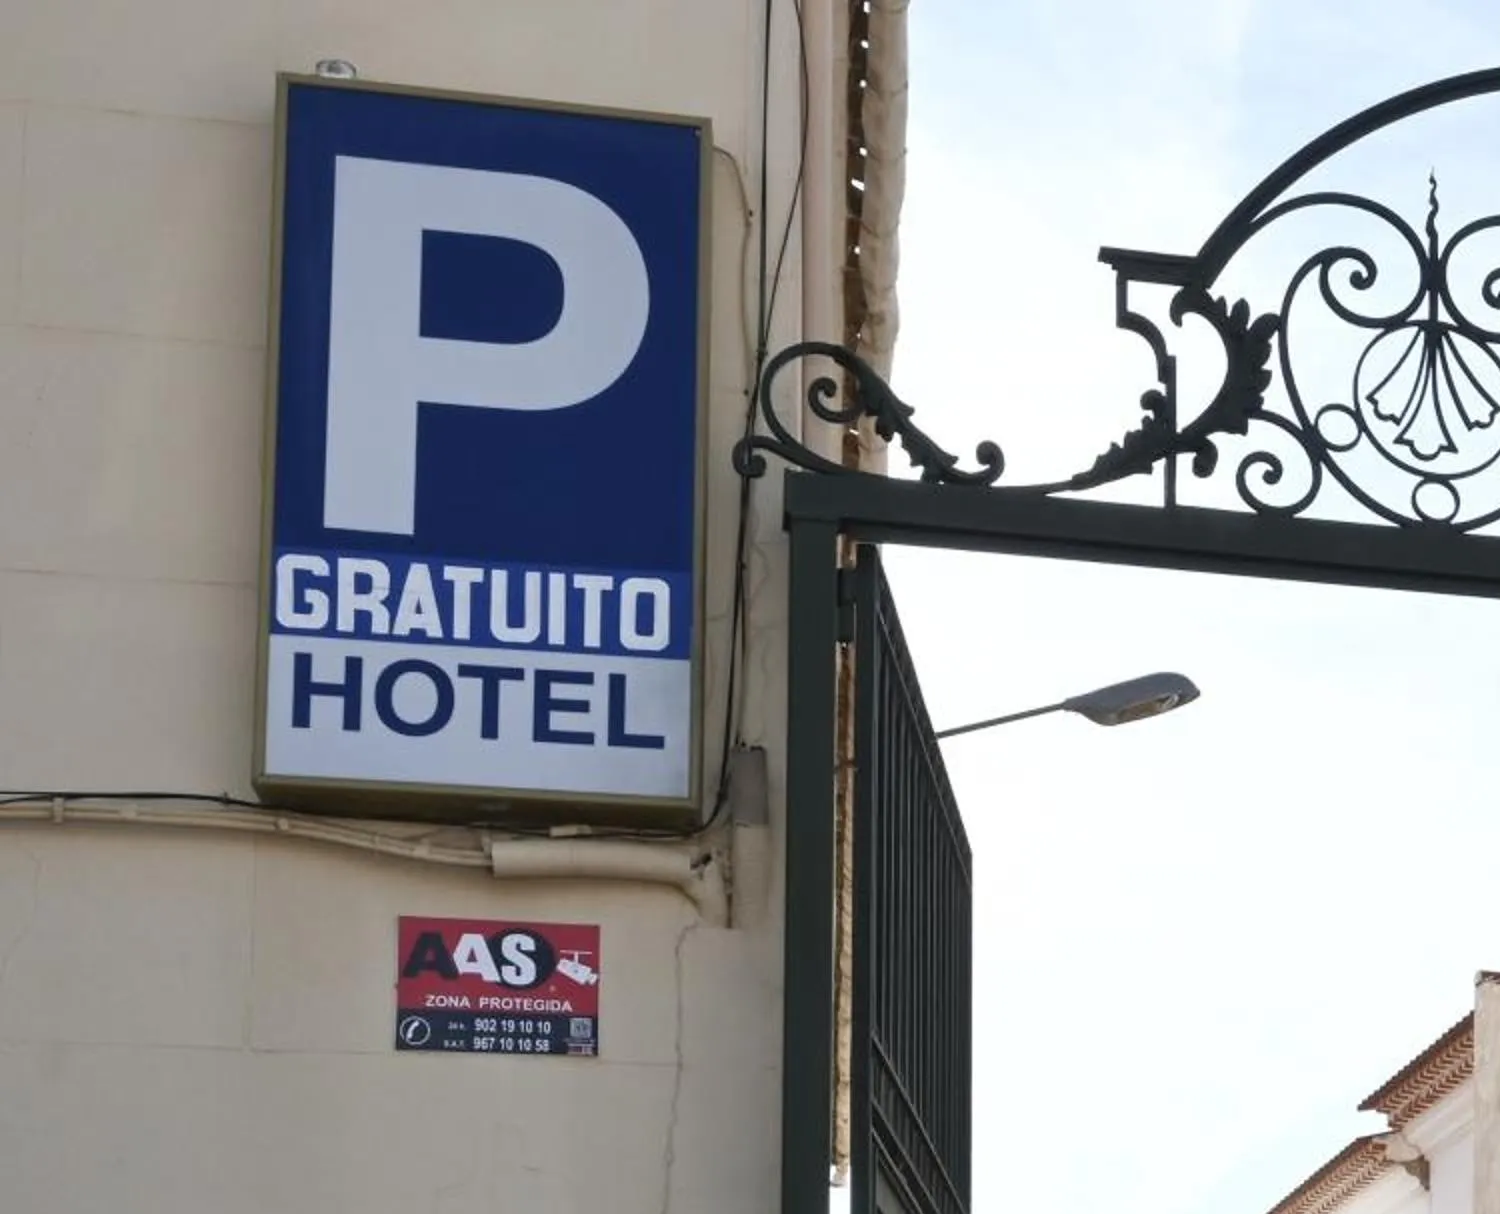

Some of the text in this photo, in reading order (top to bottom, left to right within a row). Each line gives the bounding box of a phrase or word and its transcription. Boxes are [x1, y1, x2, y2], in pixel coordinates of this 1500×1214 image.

[323, 155, 650, 535] P
[275, 553, 671, 652] GRATUITO
[291, 652, 665, 749] HOTEL
[403, 931, 537, 986] AAS
[425, 994, 573, 1013] ZONA PROTEGIDA
[474, 1017, 497, 1032] 902
[501, 1019, 515, 1033] 19
[519, 1020, 533, 1035] 10
[537, 1020, 551, 1036] 10
[500, 1037, 514, 1051] 10
[518, 1038, 532, 1051] 10
